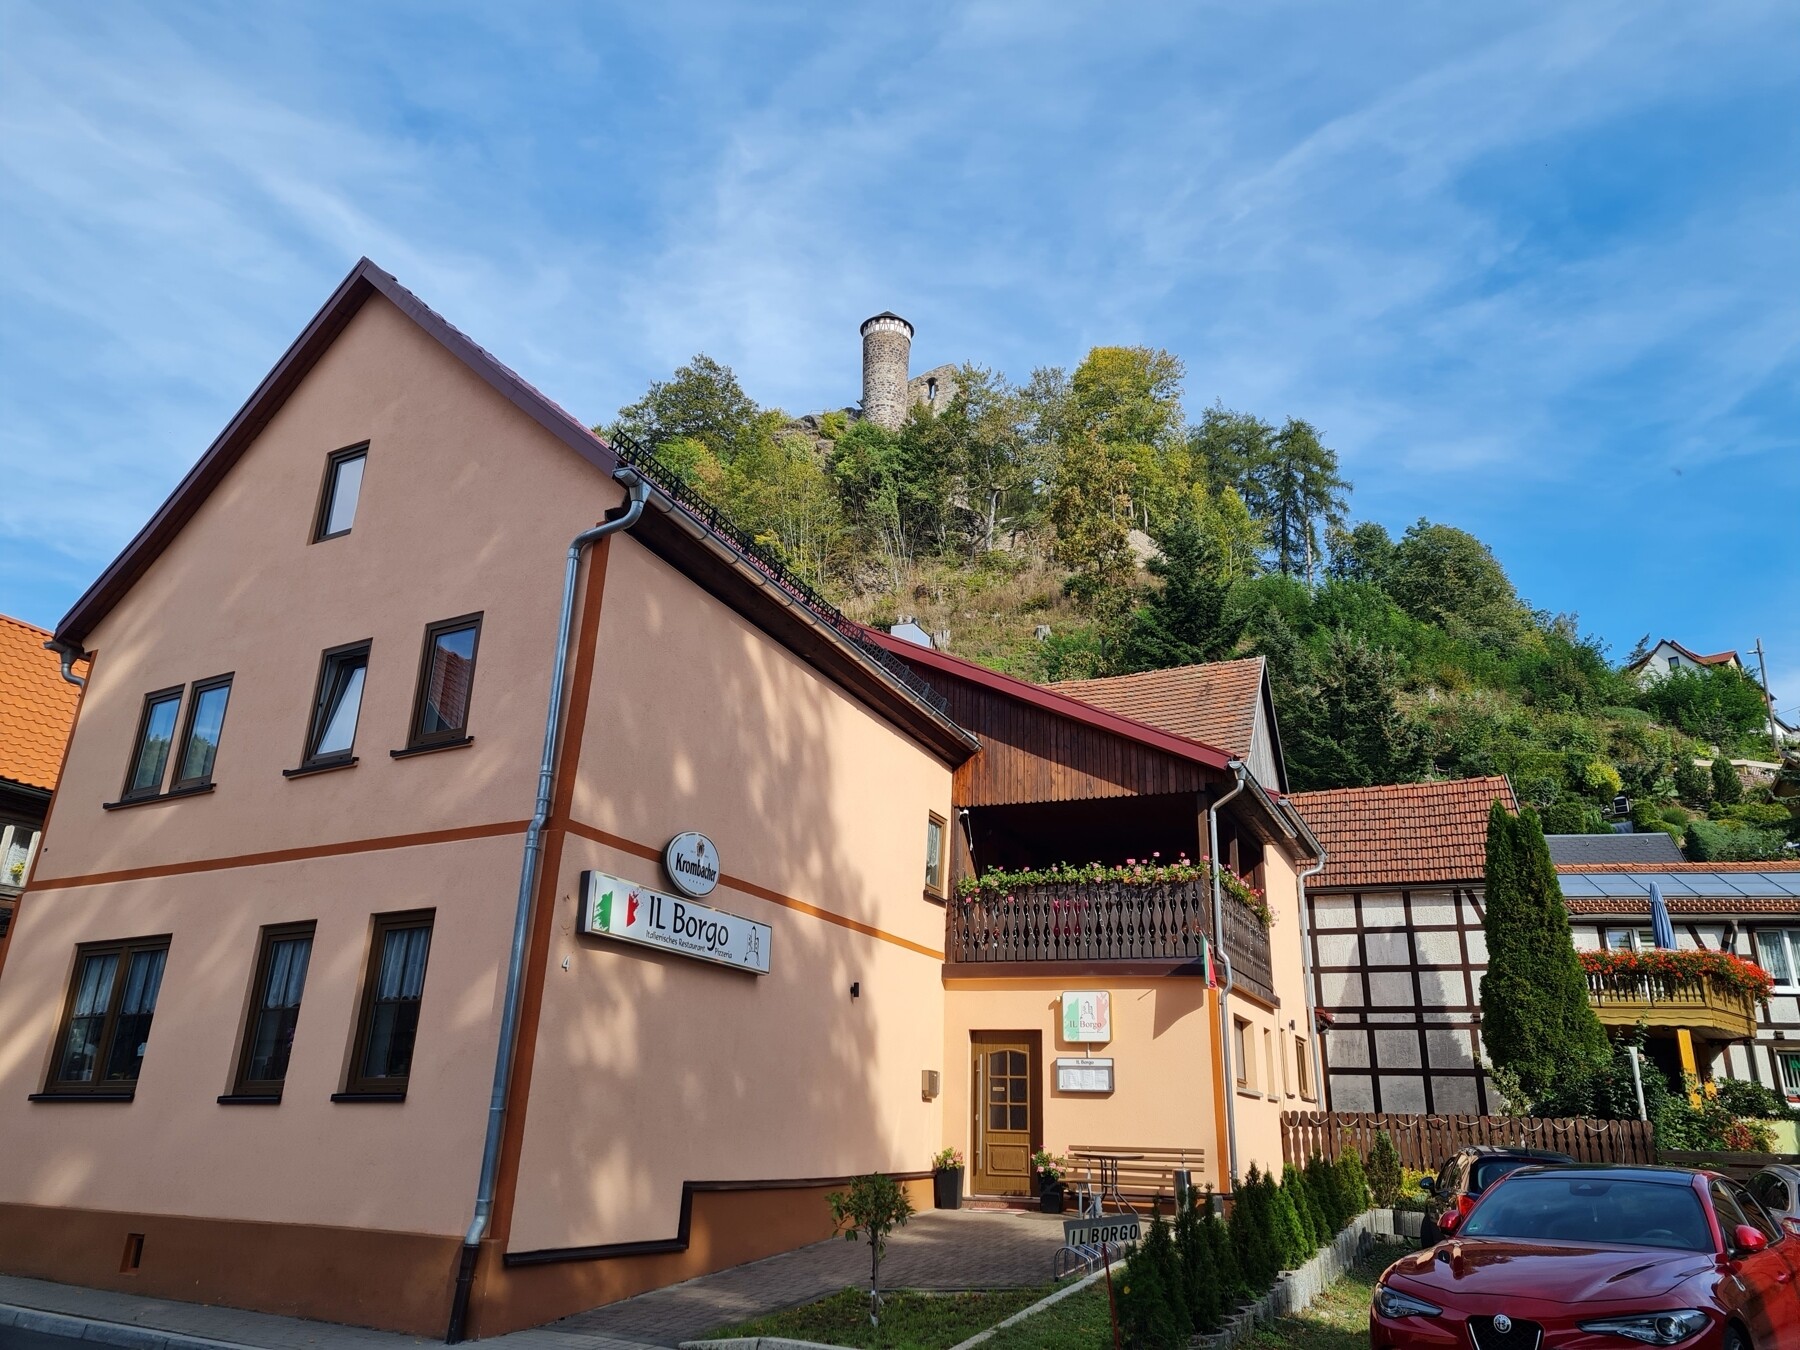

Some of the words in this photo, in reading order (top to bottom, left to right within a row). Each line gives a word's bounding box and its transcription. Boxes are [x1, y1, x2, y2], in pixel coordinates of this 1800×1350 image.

[675, 852, 717, 883] Krombacher
[649, 895, 666, 930] IL
[672, 902, 729, 951] Borgo
[646, 930, 678, 946] Italienisches
[678, 938, 706, 953] Restaurant
[714, 947, 733, 959] Pizzeria
[562, 955, 570, 971] 4
[1069, 1020, 1078, 1028] IL
[1079, 1020, 1102, 1030] Borgo
[1071, 1229, 1086, 1246] IL
[1091, 1224, 1138, 1244] BORGO
